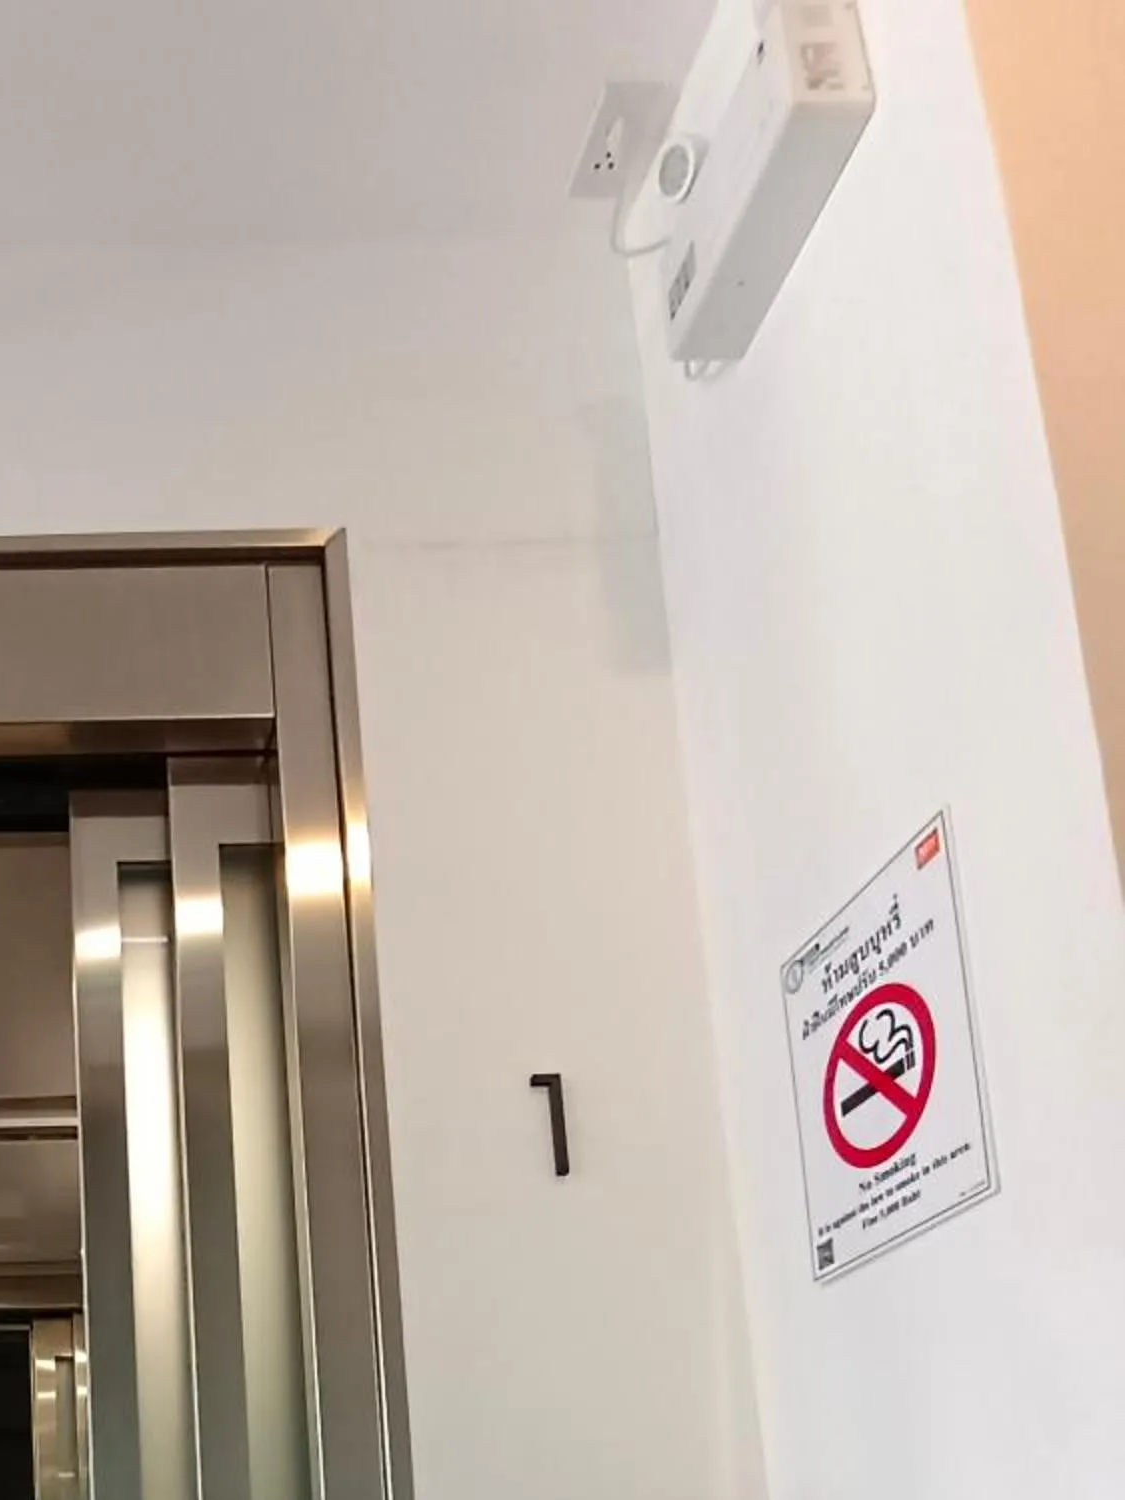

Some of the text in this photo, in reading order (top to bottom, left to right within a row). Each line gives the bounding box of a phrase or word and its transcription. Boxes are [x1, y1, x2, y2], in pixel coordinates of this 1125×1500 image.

[821, 893, 902, 994] ห้ามสูบบุหรี่
[878, 941, 907, 977] 5,000
[909, 918, 933, 948] บาท
[530, 1073, 570, 1177] 1
[874, 1152, 916, 1183] Smoking
